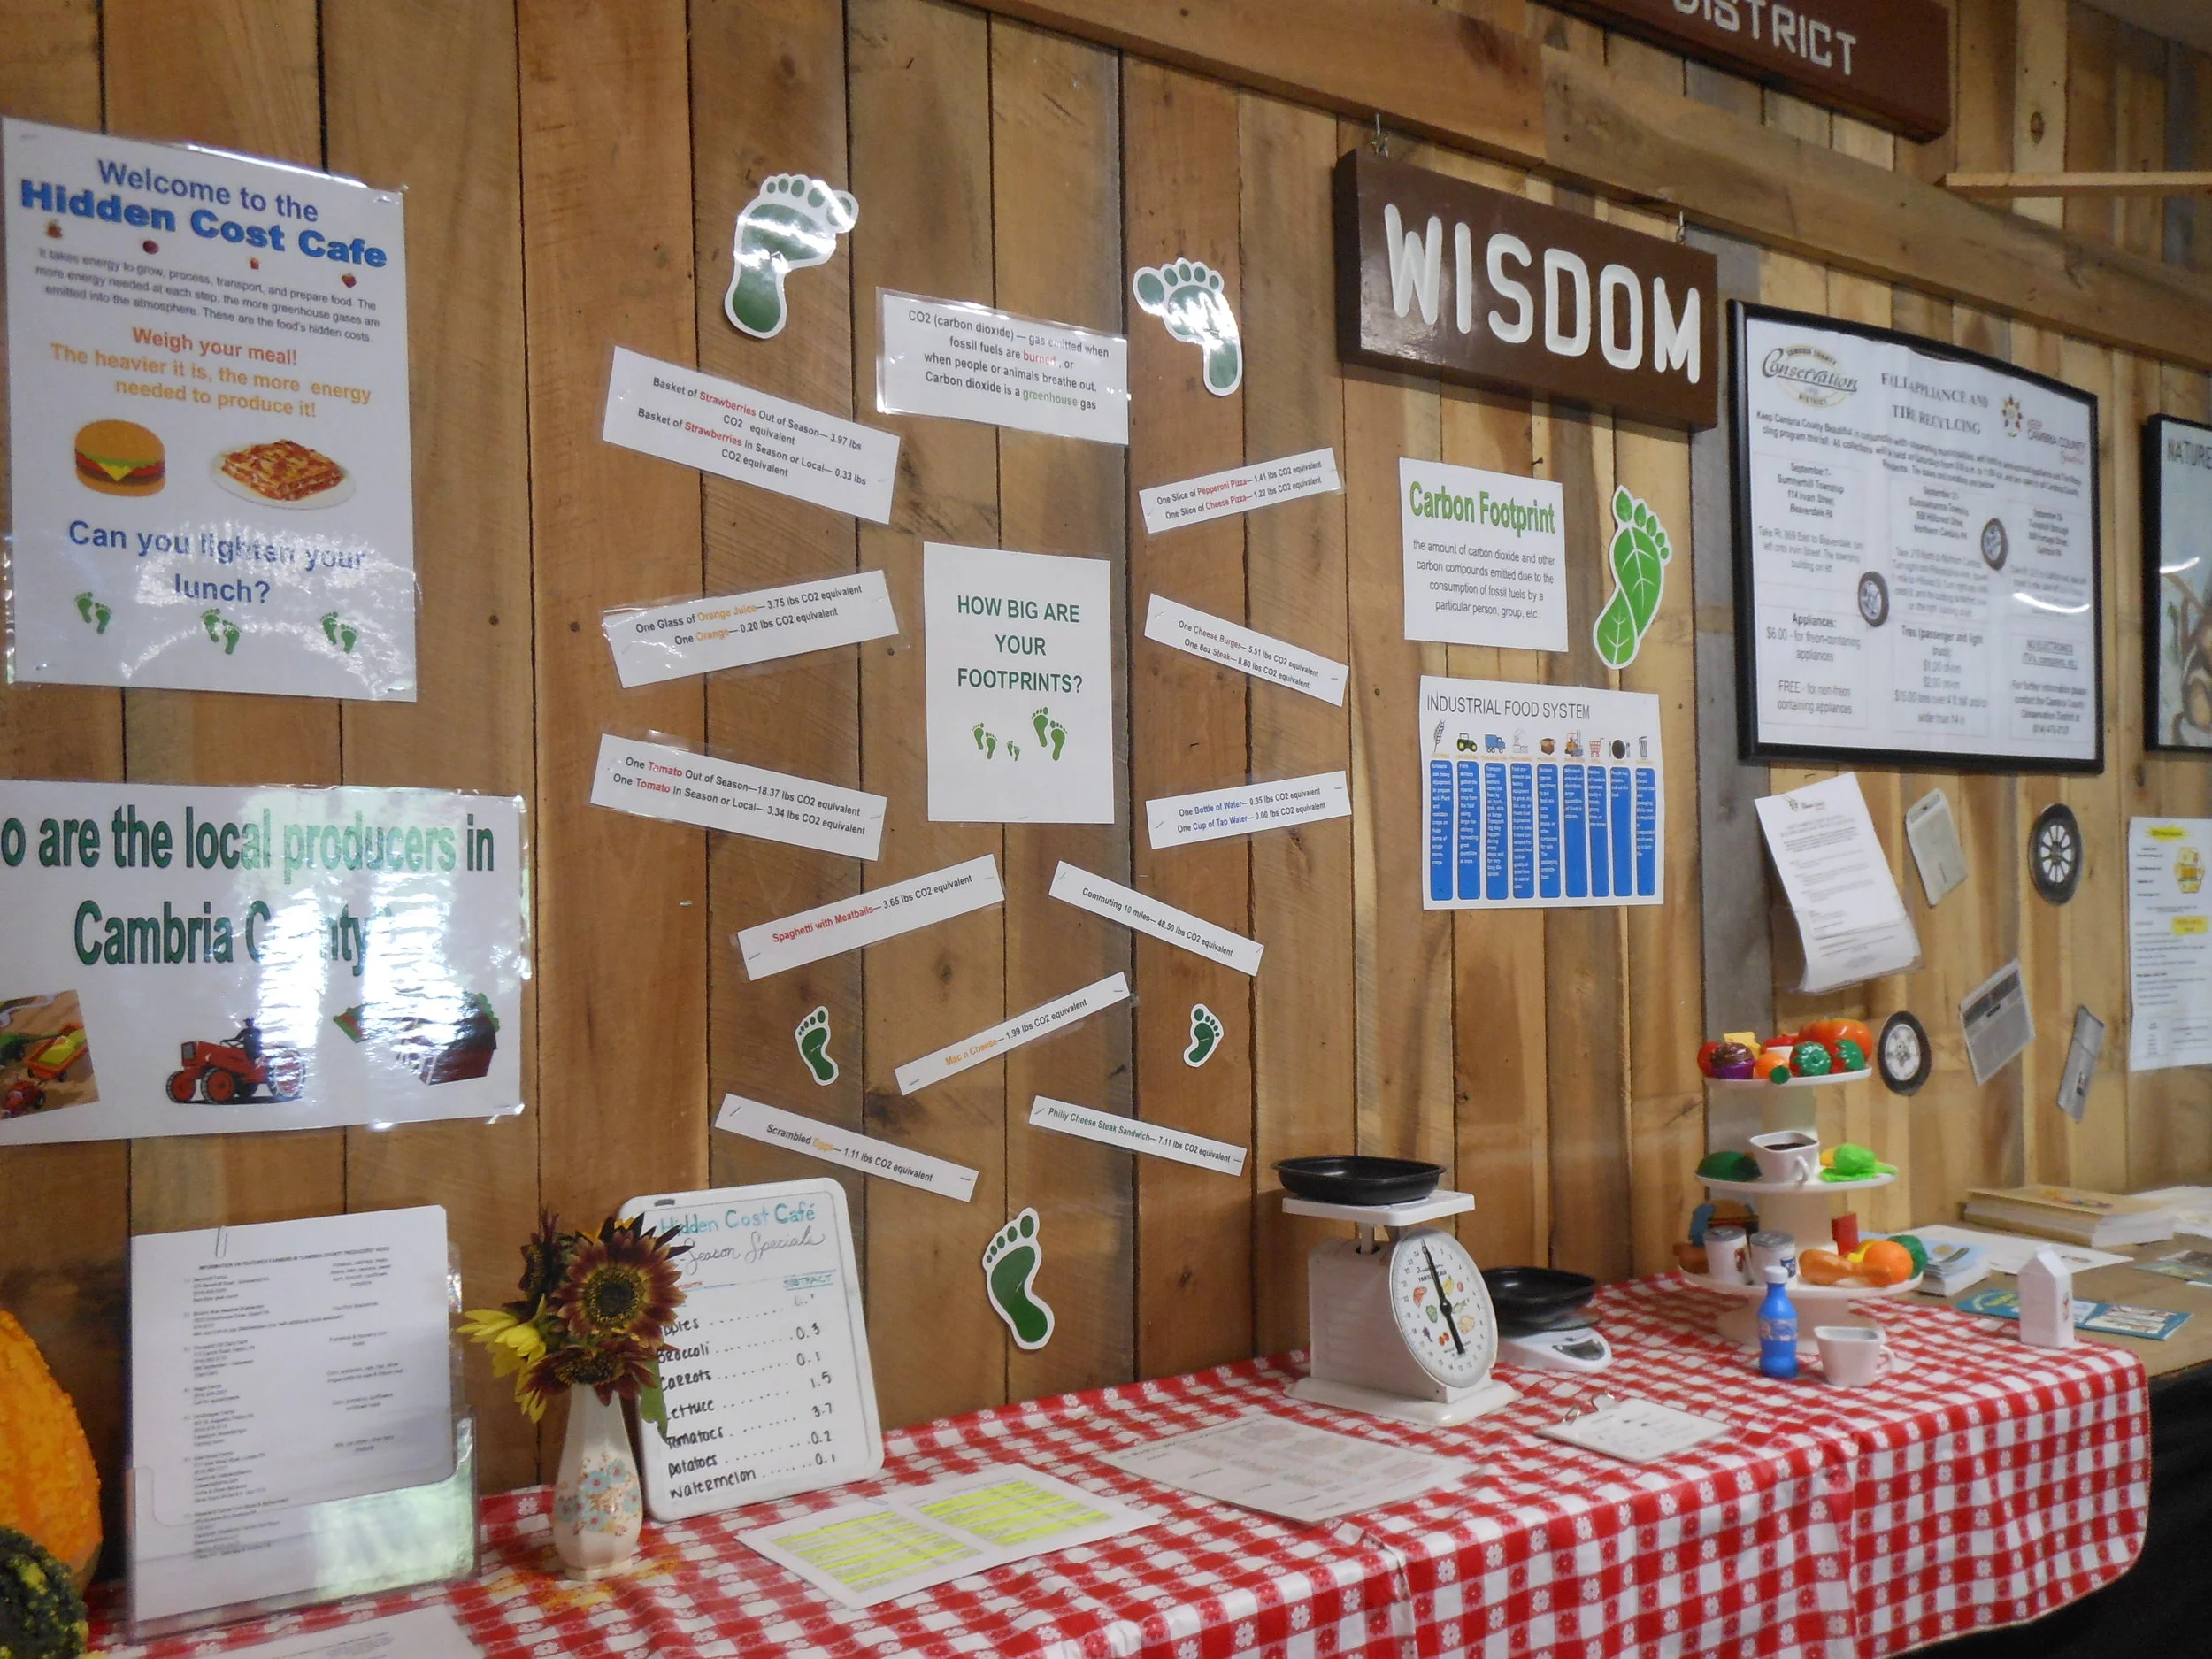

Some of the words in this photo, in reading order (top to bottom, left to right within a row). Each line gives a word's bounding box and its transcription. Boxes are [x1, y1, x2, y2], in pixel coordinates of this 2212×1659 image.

[98, 158, 231, 205] Welcome
[241, 189, 266, 212] to
[276, 194, 318, 222] the
[20, 179, 175, 232] Hidden
[190, 209, 285, 251] Cost
[298, 229, 387, 268] Cafe
[1385, 204, 1700, 384] WISDOM
[112, 295, 130, 305] the
[203, 307, 234, 322] These
[238, 315, 254, 324] are
[257, 317, 273, 327] the
[309, 324, 342, 336] hidden
[133, 327, 193, 351] Weigh
[200, 342, 242, 358] your
[249, 345, 297, 365] meal!
[950, 336, 977, 350] fossil
[980, 342, 1002, 355] fuels
[1006, 349, 1020, 359] are
[50, 343, 88, 364] The
[95, 349, 165, 374] heavier
[173, 361, 186, 376] it
[191, 364, 212, 382] is,
[219, 368, 248, 386] the
[254, 374, 299, 392] more
[311, 381, 371, 405] energy
[925, 353, 951, 365] when
[956, 359, 987, 372] people
[1003, 368, 1039, 381] animals
[1043, 373, 1077, 388] breathe
[1079, 382, 1096, 391] out.
[926, 371, 962, 386] Carbon
[966, 378, 1001, 393] dioxide
[1004, 384, 1011, 395] is
[1023, 390, 1078, 406] greenhouse
[1080, 400, 1095, 411] gas
[115, 380, 182, 400] needed
[192, 388, 211, 403] to
[218, 392, 293, 415] produce
[299, 400, 315, 418] it!
[653, 377, 685, 395] Basket
[700, 391, 756, 417] Strawberries
[759, 411, 778, 423] Out
[831, 434, 848, 445] 3.97
[849, 440, 862, 450] lbs
[1410, 481, 1474, 522] Carbon
[1479, 491, 1555, 537] Footprint
[70, 520, 127, 549] Can
[137, 532, 188, 557] you
[201, 534, 295, 565] lighten
[304, 545, 365, 572] your
[174, 573, 270, 603] lunch?
[1436, 602, 1471, 611] particular
[675, 636, 694, 645] One
[741, 622, 758, 633] 0.20
[760, 620, 773, 629] lbs
[776, 615, 794, 626] CO2
[796, 608, 838, 623] equivalent
[958, 595, 1002, 616] HOW
[1008, 600, 1038, 619] BIG
[1044, 603, 1079, 622] ARE
[995, 634, 1046, 655] YOUR
[958, 668, 1082, 693] FOOTPRINTS?
[1778, 680, 1801, 693] FREE
[1427, 695, 1501, 715] INDUSTRIAL
[1505, 700, 1539, 717] FOOD
[1543, 703, 1589, 720] SYSTEM
[626, 757, 645, 769] One
[649, 762, 682, 777] Tomato
[686, 770, 702, 781] Out
[782, 791, 794, 801] lbs
[797, 795, 815, 806] CO2
[818, 801, 860, 816] equivalent
[1194, 805, 1217, 814] Bottle
[1250, 796, 1263, 805] 0.35
[1290, 788, 1320, 800] equivalent
[39, 818, 100, 868] are
[112, 805, 173, 868] the
[187, 806, 271, 870] local
[285, 810, 457, 885] producers
[467, 815, 494, 871] in
[772, 925, 814, 943] Spaghetti
[814, 918, 833, 932] with
[883, 900, 900, 910] 3.65
[902, 894, 913, 903] lbs
[915, 887, 932, 899] CO2
[933, 875, 972, 894] equivalent
[1083, 888, 1122, 911] Commuting
[1158, 919, 1175, 932] 48.50
[1176, 926, 1185, 937] lbs
[1187, 932, 1201, 942] CO2
[1202, 939, 1233, 956] equivalent
[75, 901, 233, 964] Cambria
[1048, 1108, 1069, 1121] Philly
[1071, 1113, 1096, 1126] Cheese
[1098, 1120, 1119, 1133] Steak
[1159, 1136, 1171, 1146] 7.11
[1173, 1141, 1182, 1149] lbs
[1185, 1143, 1200, 1154] CO2
[1199, 1149, 1230, 1163] equivalent
[725, 1207, 769, 1228] Cost
[774, 1201, 815, 1224] Café
[745, 1225, 826, 1263] Specials
